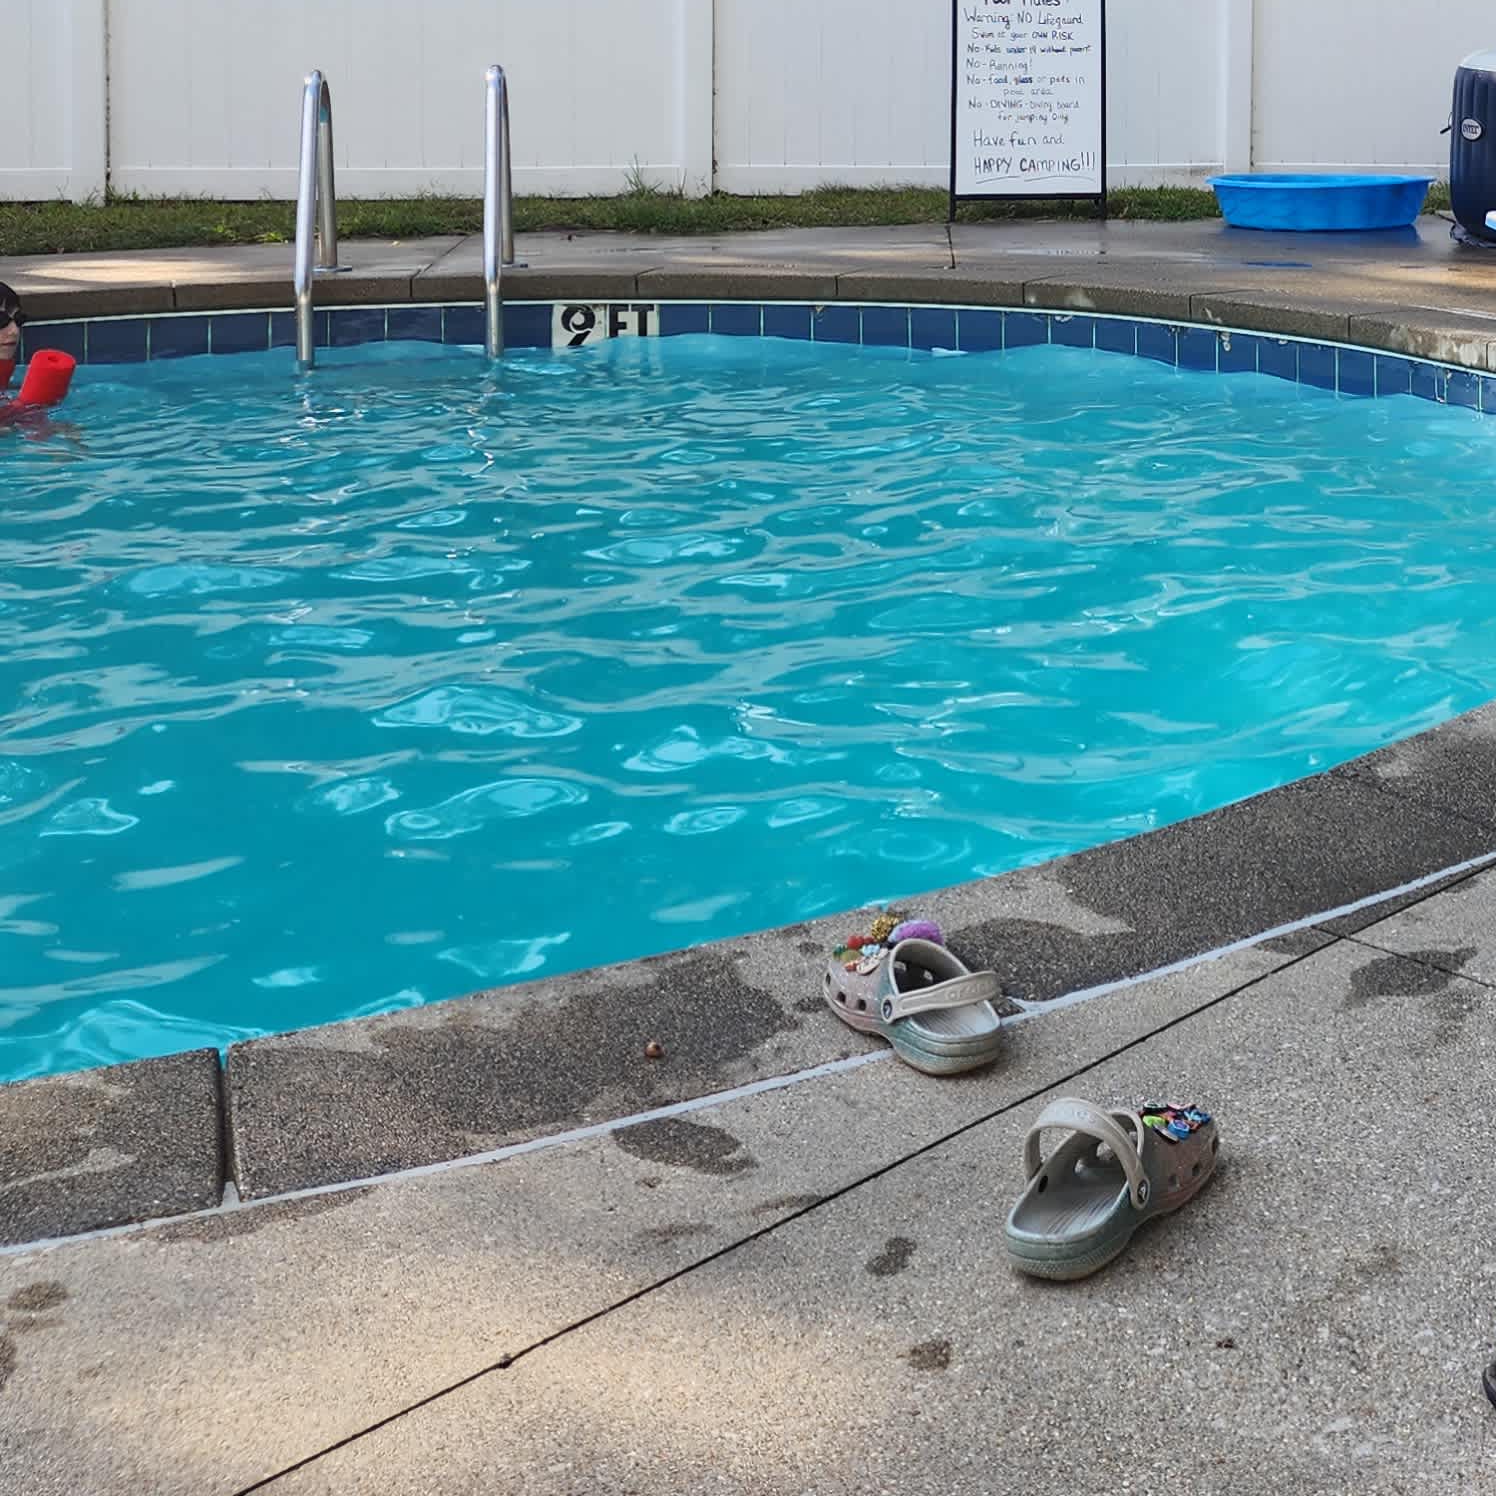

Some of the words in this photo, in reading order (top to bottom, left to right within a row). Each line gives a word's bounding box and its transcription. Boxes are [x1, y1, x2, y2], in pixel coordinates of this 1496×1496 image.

[1052, 31, 1074, 40] RISK
[973, 128, 1005, 147] Have
[1009, 130, 1037, 148] fun
[1043, 133, 1064, 145] and
[975, 157, 1012, 175] HAPPY
[561, 304, 595, 346] 9
[608, 304, 655, 338] FT
